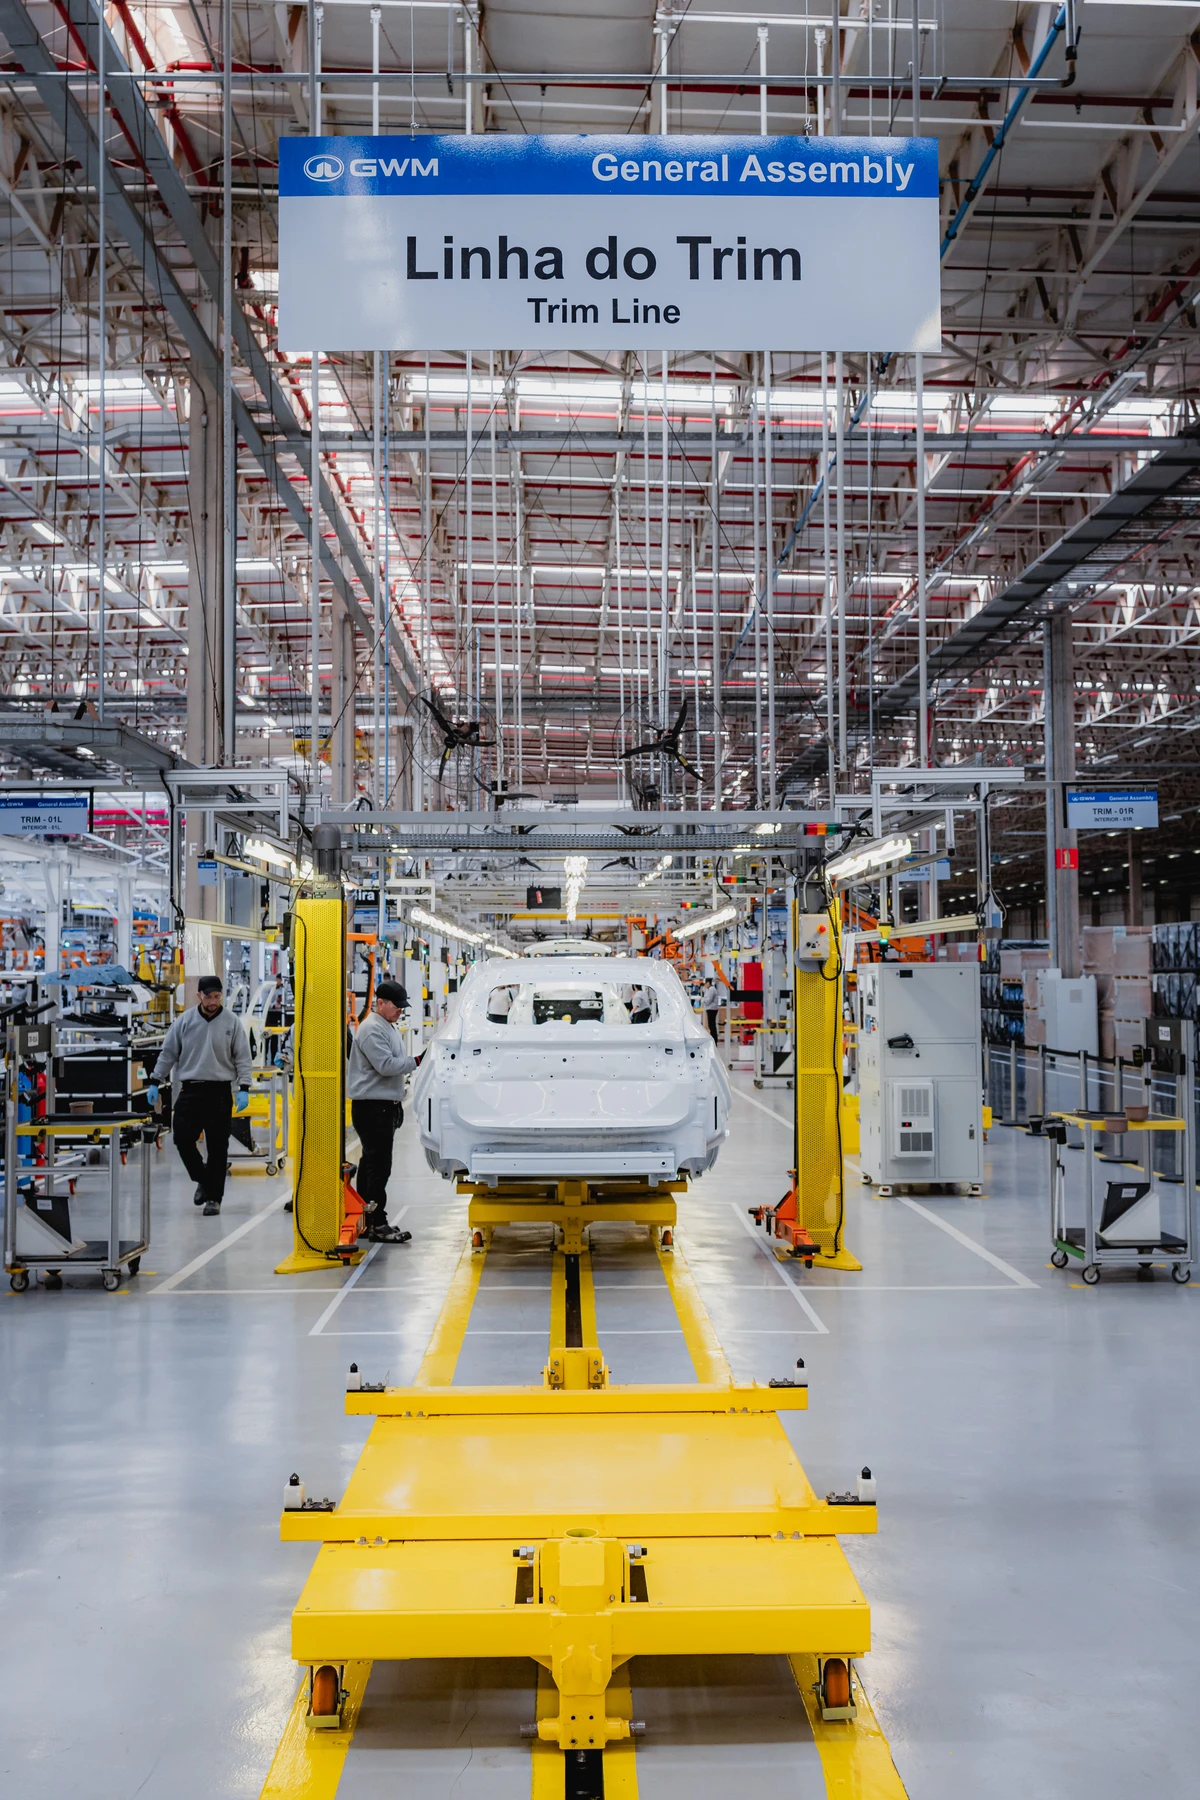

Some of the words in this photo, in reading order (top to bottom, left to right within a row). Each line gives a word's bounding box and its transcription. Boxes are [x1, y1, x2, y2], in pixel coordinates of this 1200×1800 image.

[349, 158, 440, 178] GWM
[591, 153, 730, 184] General
[738, 154, 915, 192] Assembly
[406, 235, 563, 281] Linha
[585, 235, 656, 281] do
[676, 235, 802, 281] Trim
[527, 298, 600, 324] Trim
[611, 298, 681, 325] Line
[1119, 807, 1134, 815] 01R
